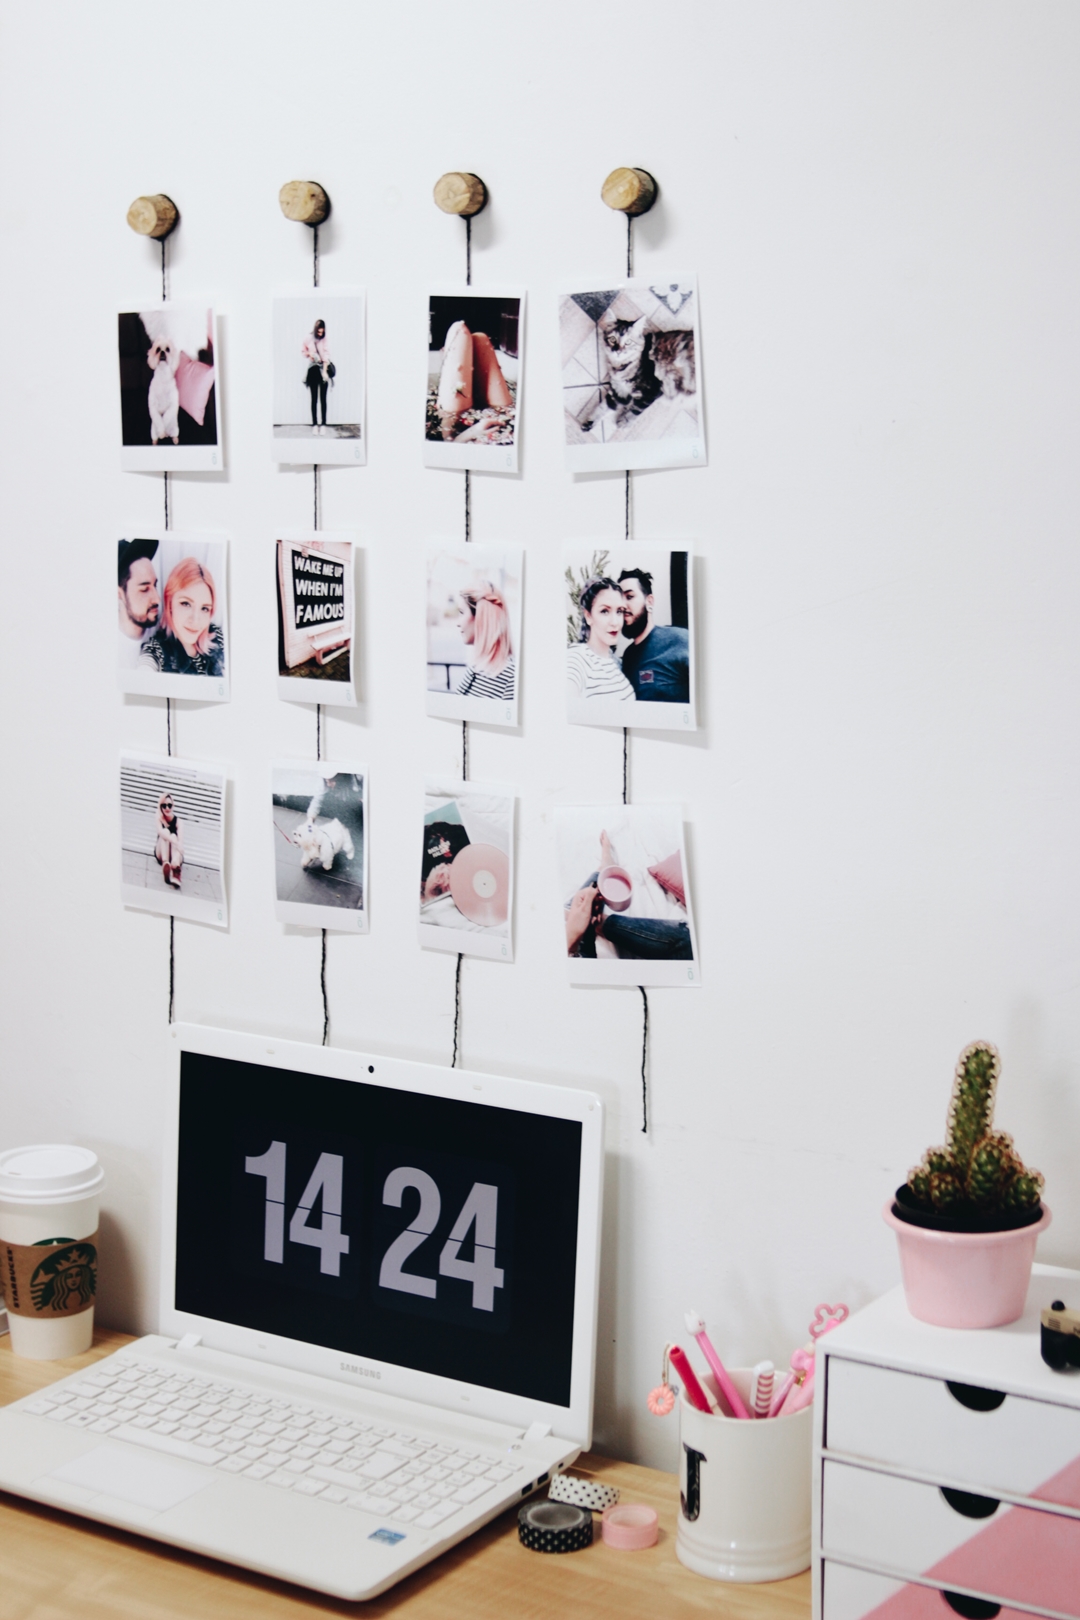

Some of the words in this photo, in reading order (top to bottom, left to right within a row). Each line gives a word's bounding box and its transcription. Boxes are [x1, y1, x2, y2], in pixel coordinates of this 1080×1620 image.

[294, 556, 321, 574] WAKE
[322, 564, 333, 576] ME
[334, 566, 343, 577] UP
[295, 579, 328, 596] WHEN
[329, 583, 343, 597] I'M
[296, 603, 343, 623] FAMOUS
[245, 1140, 349, 1277] 14
[379, 1166, 504, 1312] 24
[7, 1249, 19, 1308] STARBUCKS
[340, 1362, 381, 1379] SAMSUNG
[680, 1441, 708, 1522] J
